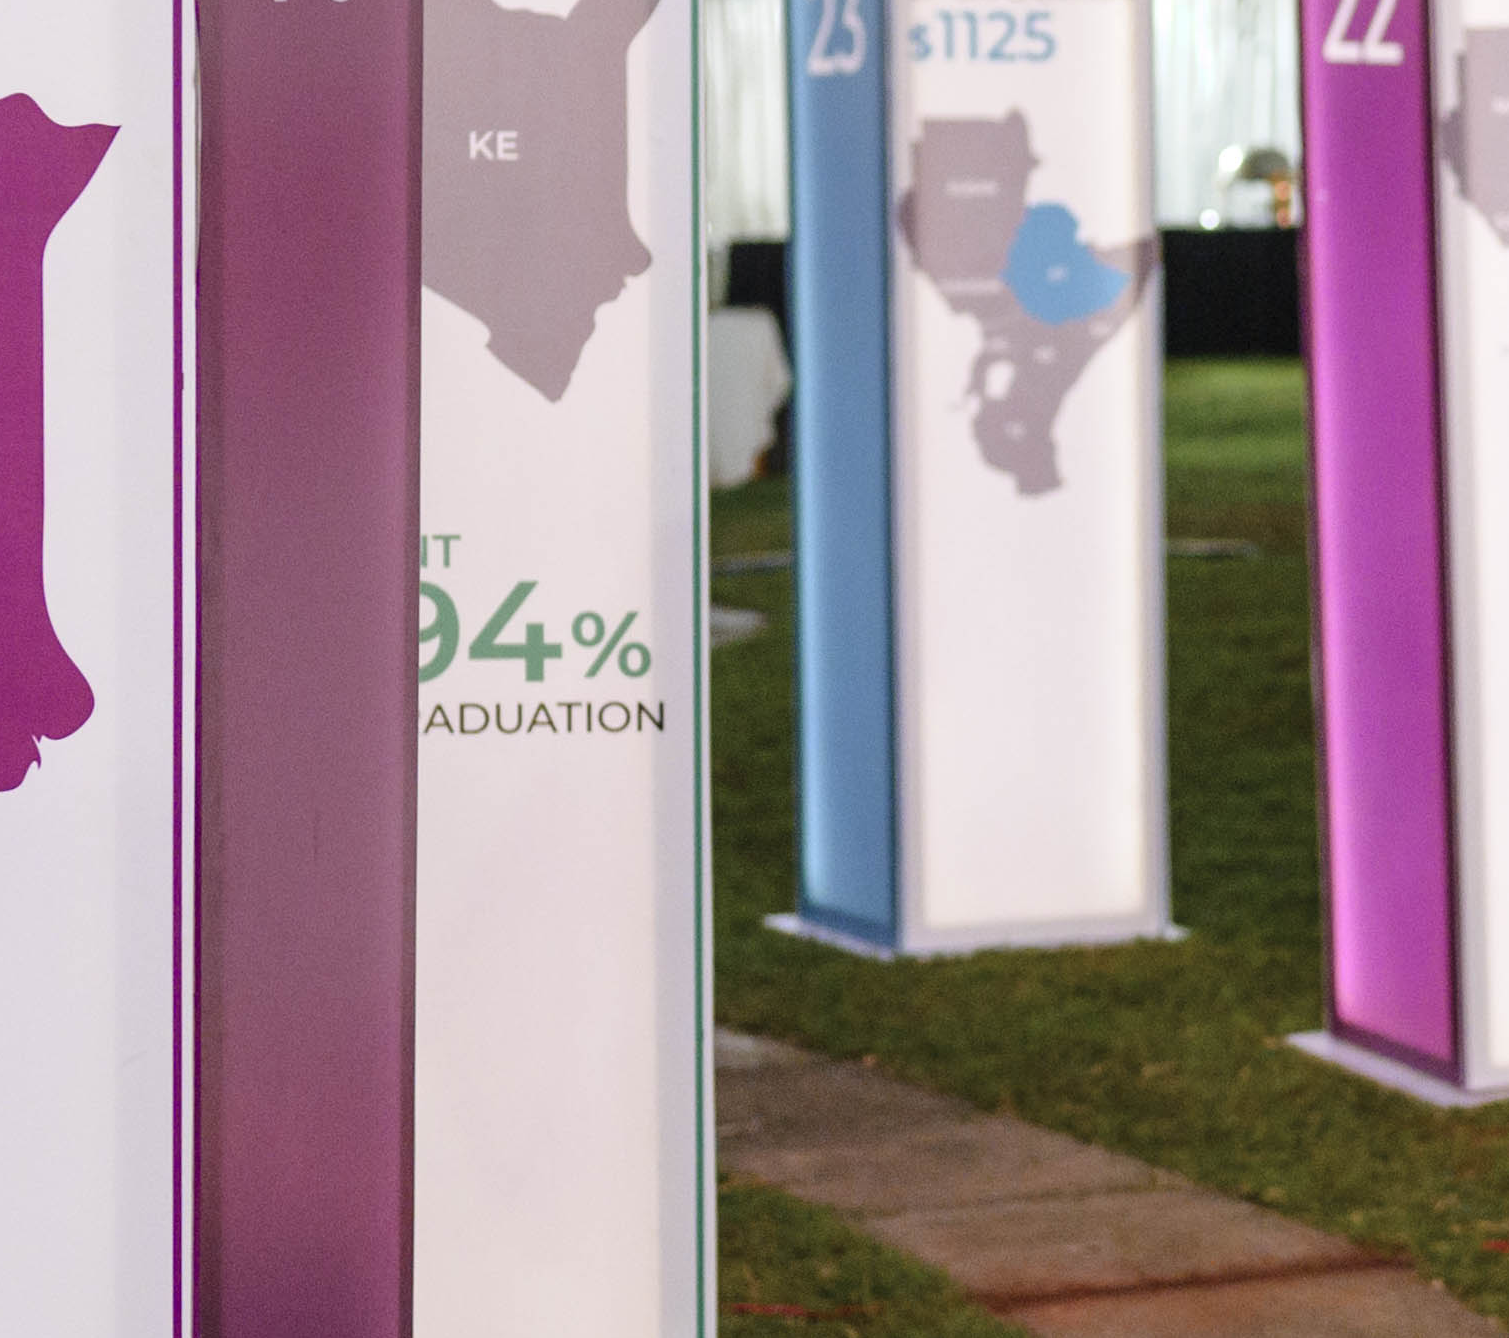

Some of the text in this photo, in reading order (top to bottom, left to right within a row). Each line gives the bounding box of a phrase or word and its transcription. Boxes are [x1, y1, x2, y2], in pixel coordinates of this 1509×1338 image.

[908, 11, 1056, 62] $1125
[469, 130, 519, 161] KE
[419, 580, 651, 684] 94%
